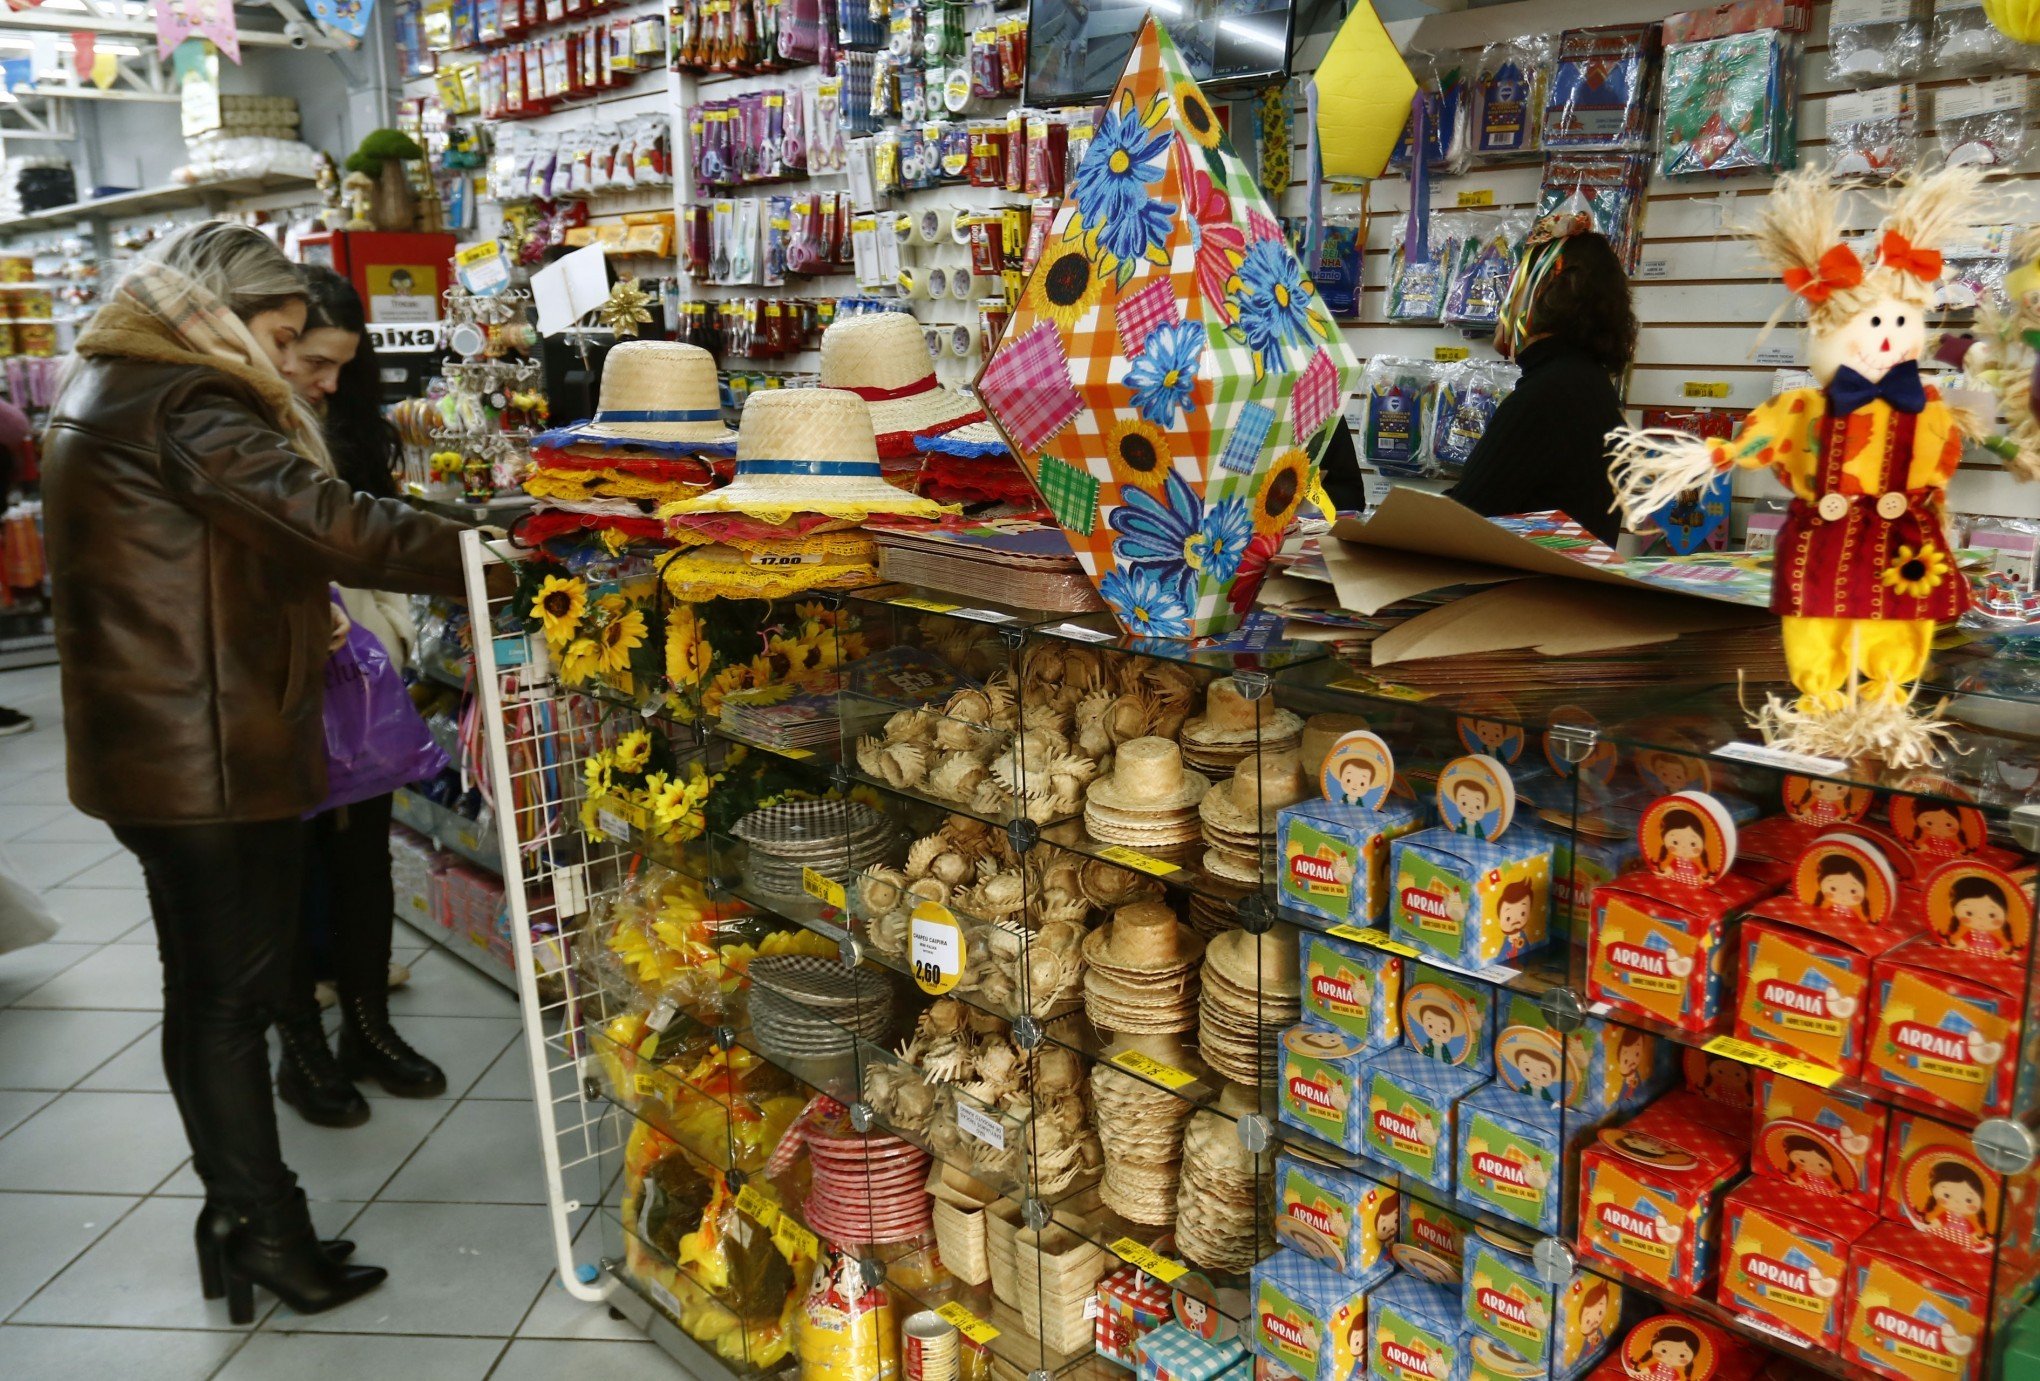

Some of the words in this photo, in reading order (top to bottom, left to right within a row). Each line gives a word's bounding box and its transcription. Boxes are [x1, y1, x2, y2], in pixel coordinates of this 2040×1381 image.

[369, 328, 435, 349] aixa
[1613, 947, 1664, 976] ARRAIÁ
[1763, 984, 1822, 1016] ARRAIÁ
[1897, 1026, 1965, 1061] ARRAIÁ
[1603, 1207, 1653, 1240] ARRAIÁ
[1747, 1258, 1805, 1293] ARRAIÁ
[1874, 1312, 1939, 1351] ARRAIÁ
